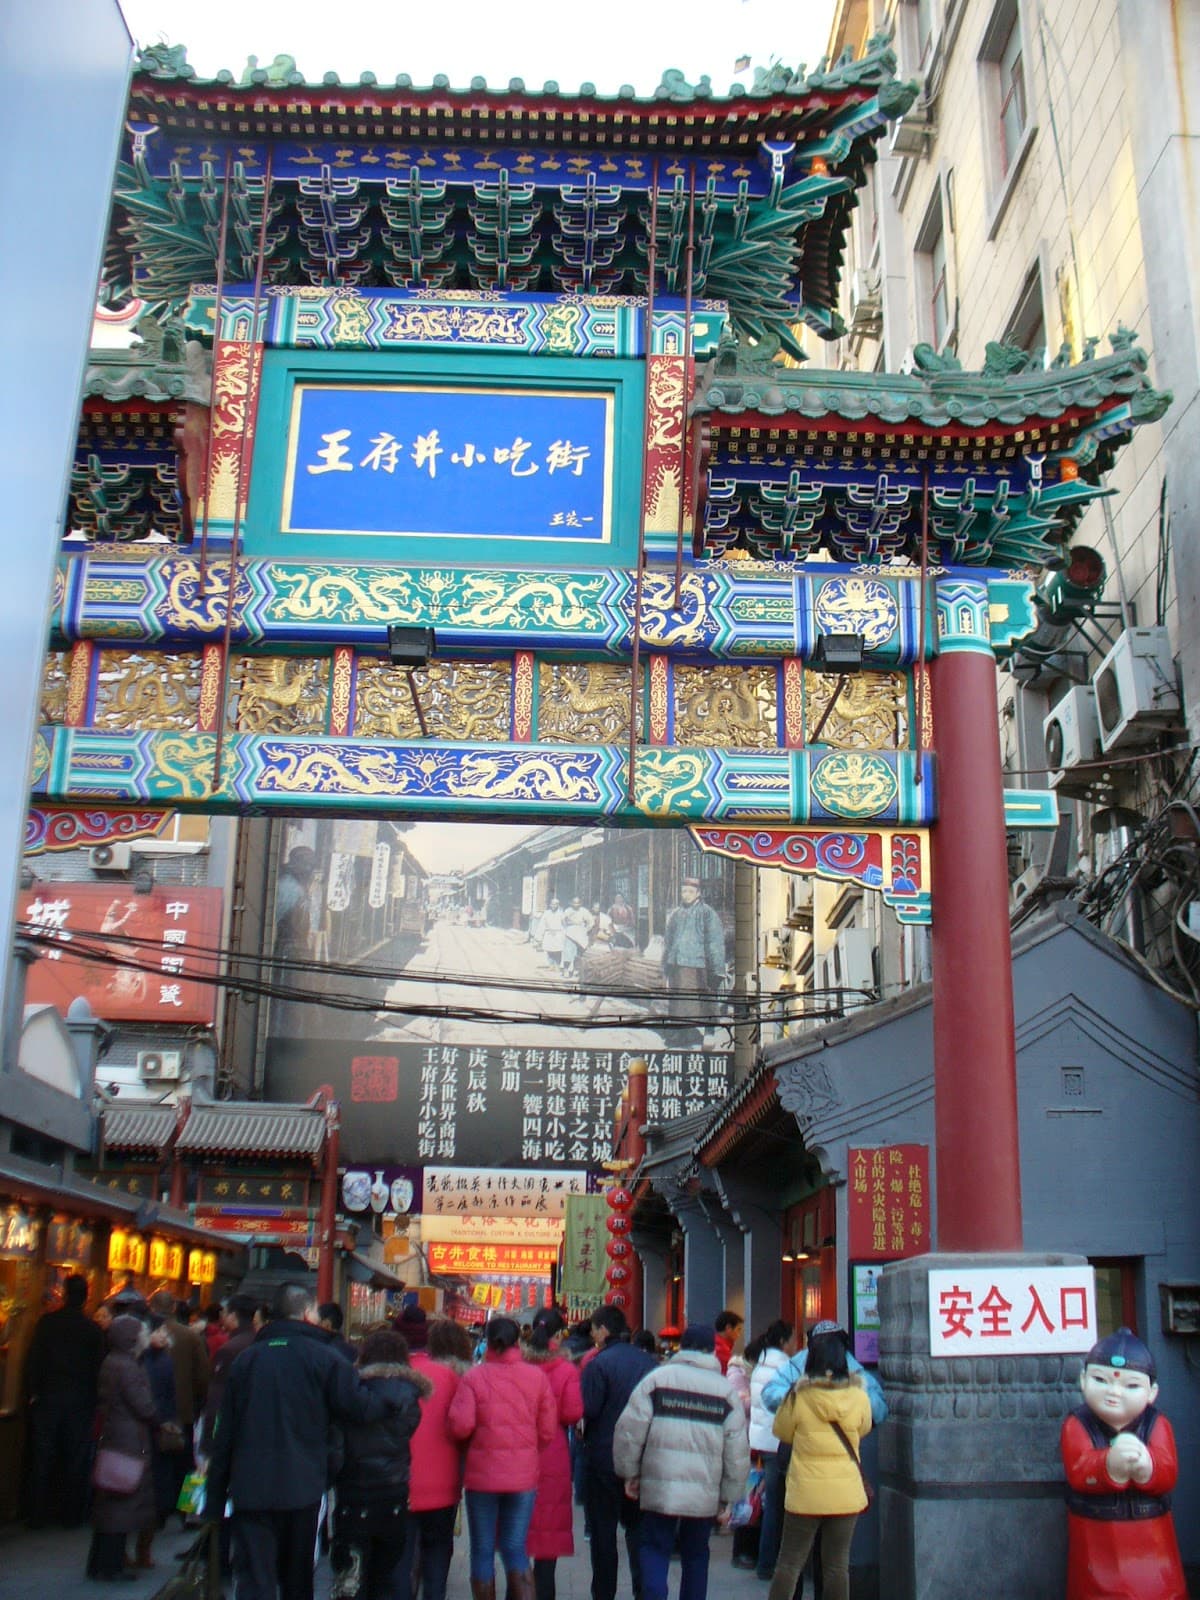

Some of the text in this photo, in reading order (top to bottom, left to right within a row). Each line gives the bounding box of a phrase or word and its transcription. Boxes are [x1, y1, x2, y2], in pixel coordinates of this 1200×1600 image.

[307, 429, 591, 478] 王府井小吃街
[418, 1047, 438, 1158] 王府井小吃街
[437, 1047, 460, 1158] 好友世界商場
[466, 1047, 488, 1113] 庚辰秋
[545, 1049, 567, 1161] 街興建小吃
[568, 1051, 590, 1161] 最繁華之金
[939, 1284, 1088, 1339] 安全入口
